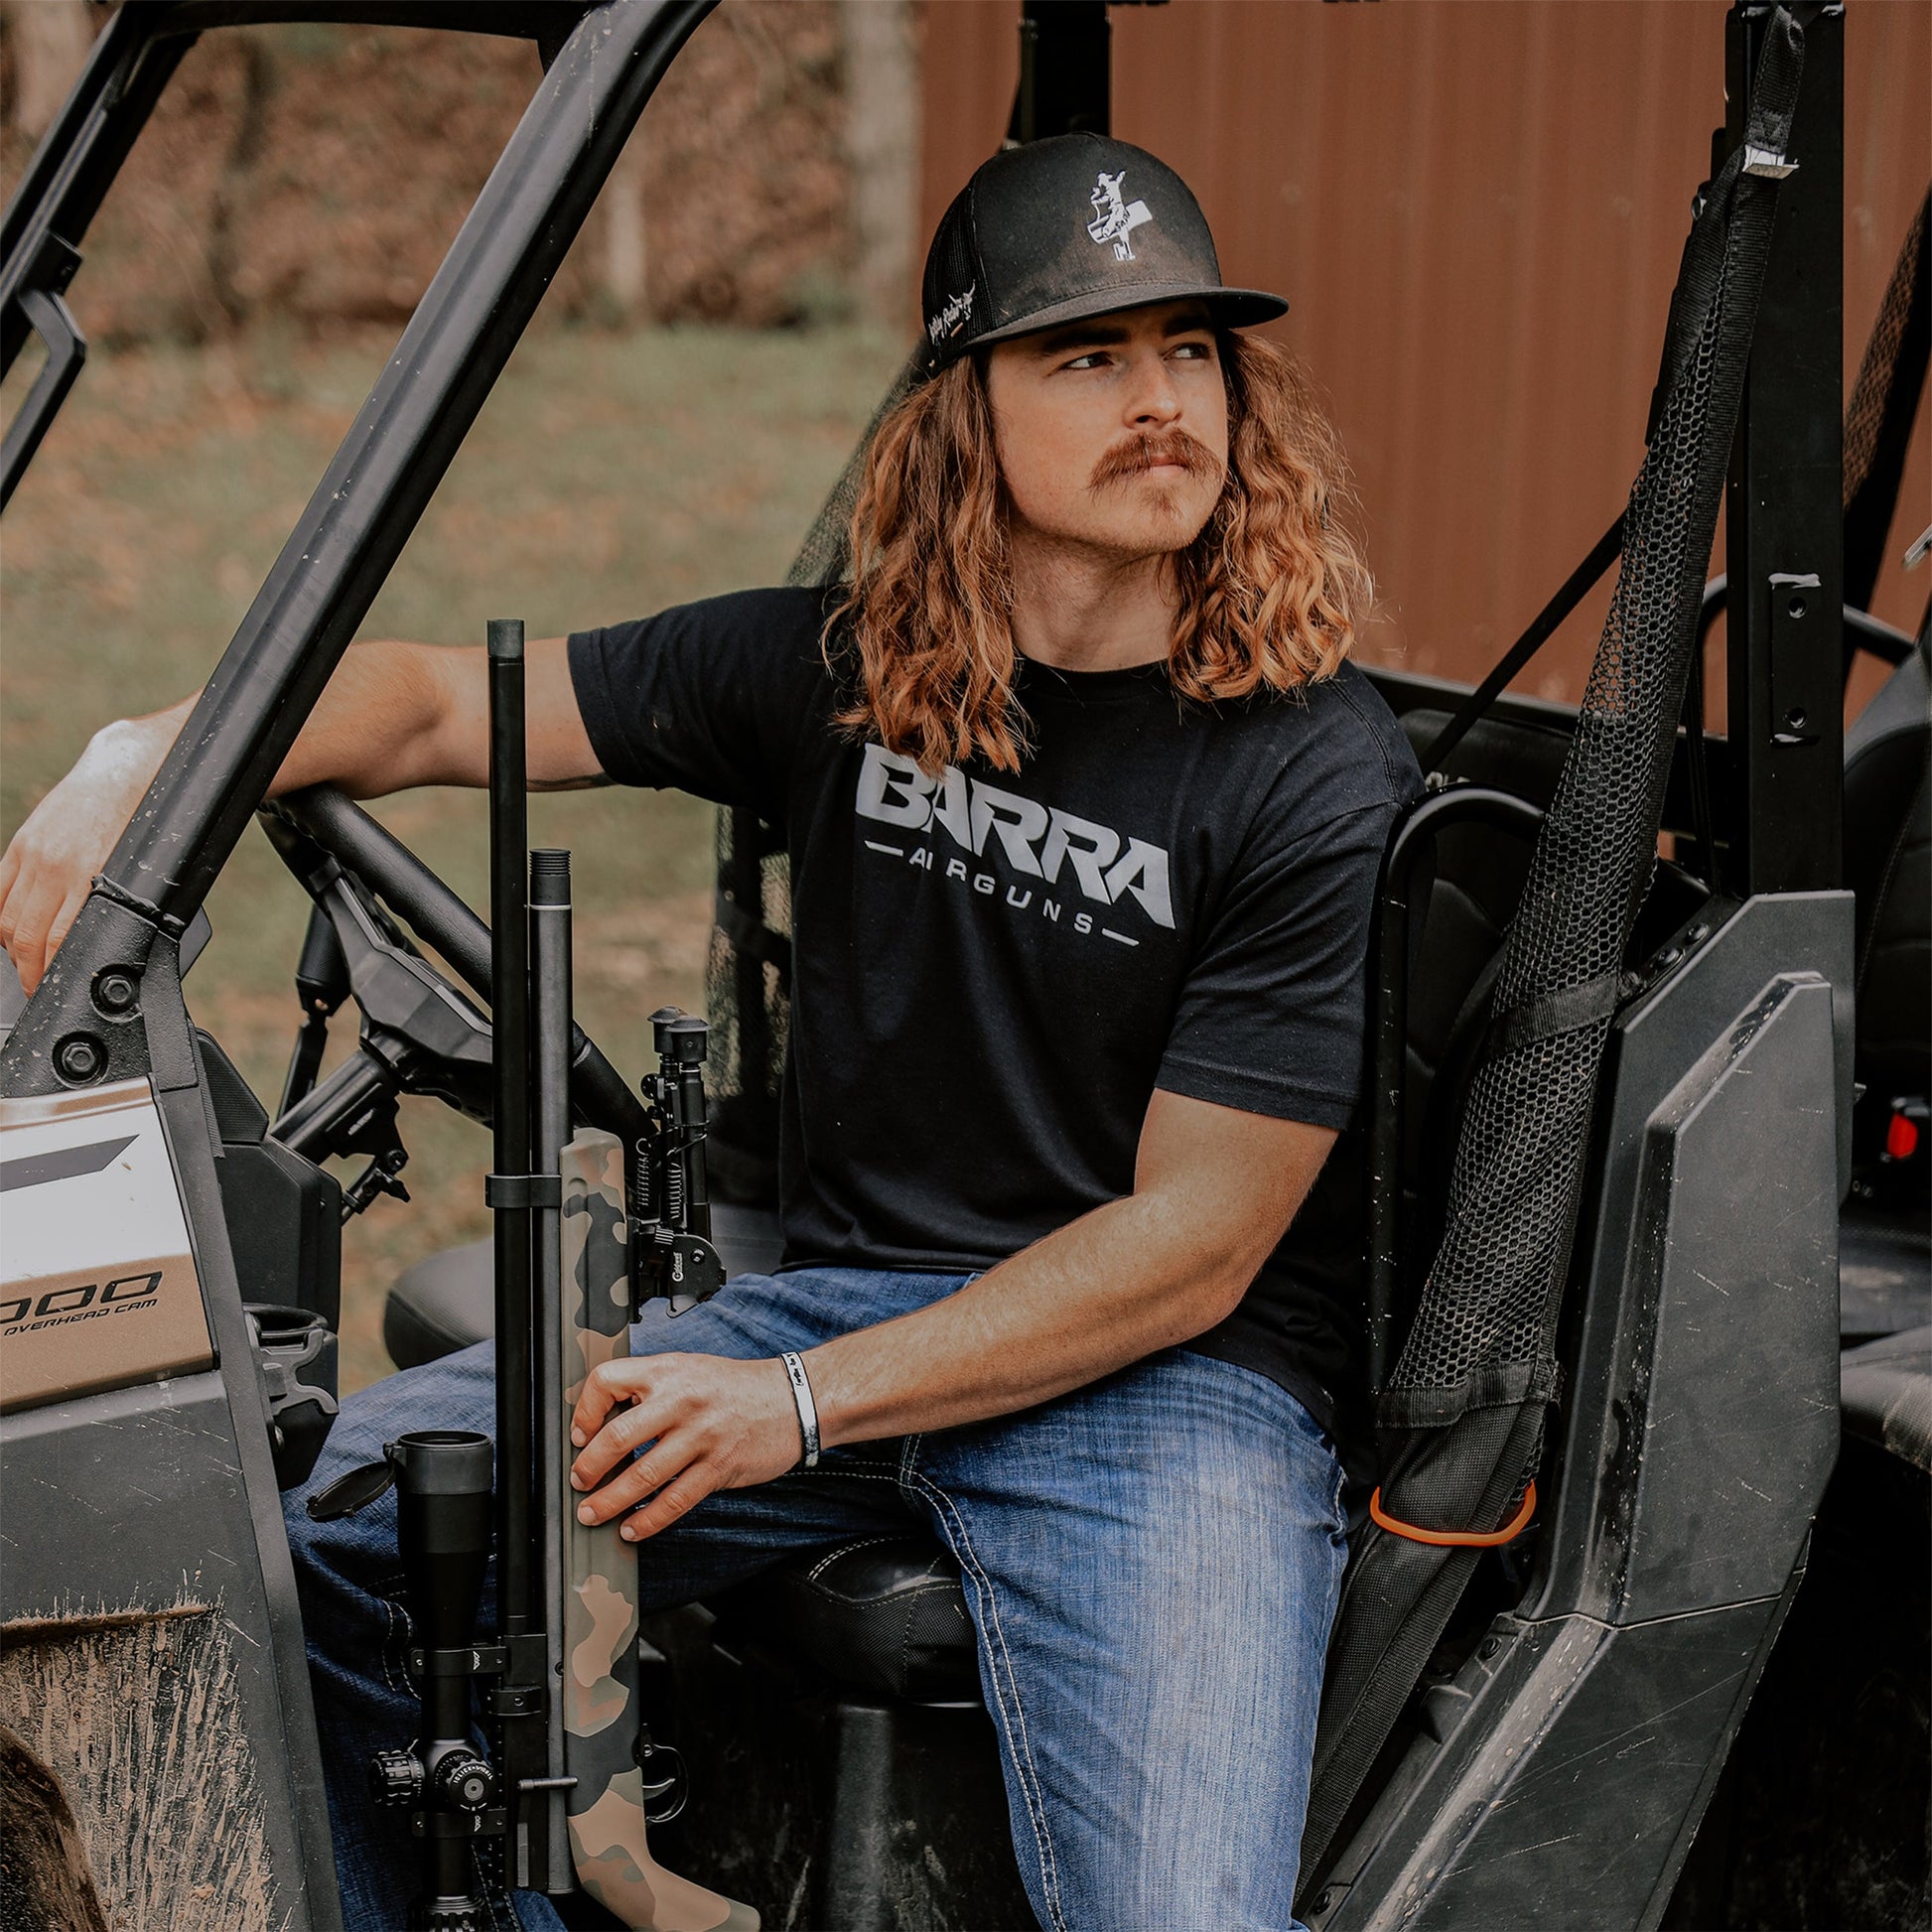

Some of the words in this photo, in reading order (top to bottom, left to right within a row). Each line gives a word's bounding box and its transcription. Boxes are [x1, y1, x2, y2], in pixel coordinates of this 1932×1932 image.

[855, 743, 1176, 930] BARRA
[908, 846, 1093, 935] AIRGUNS
[4, 1308, 111, 1336] OVERHEAD
[114, 1299, 159, 1314] CAM
